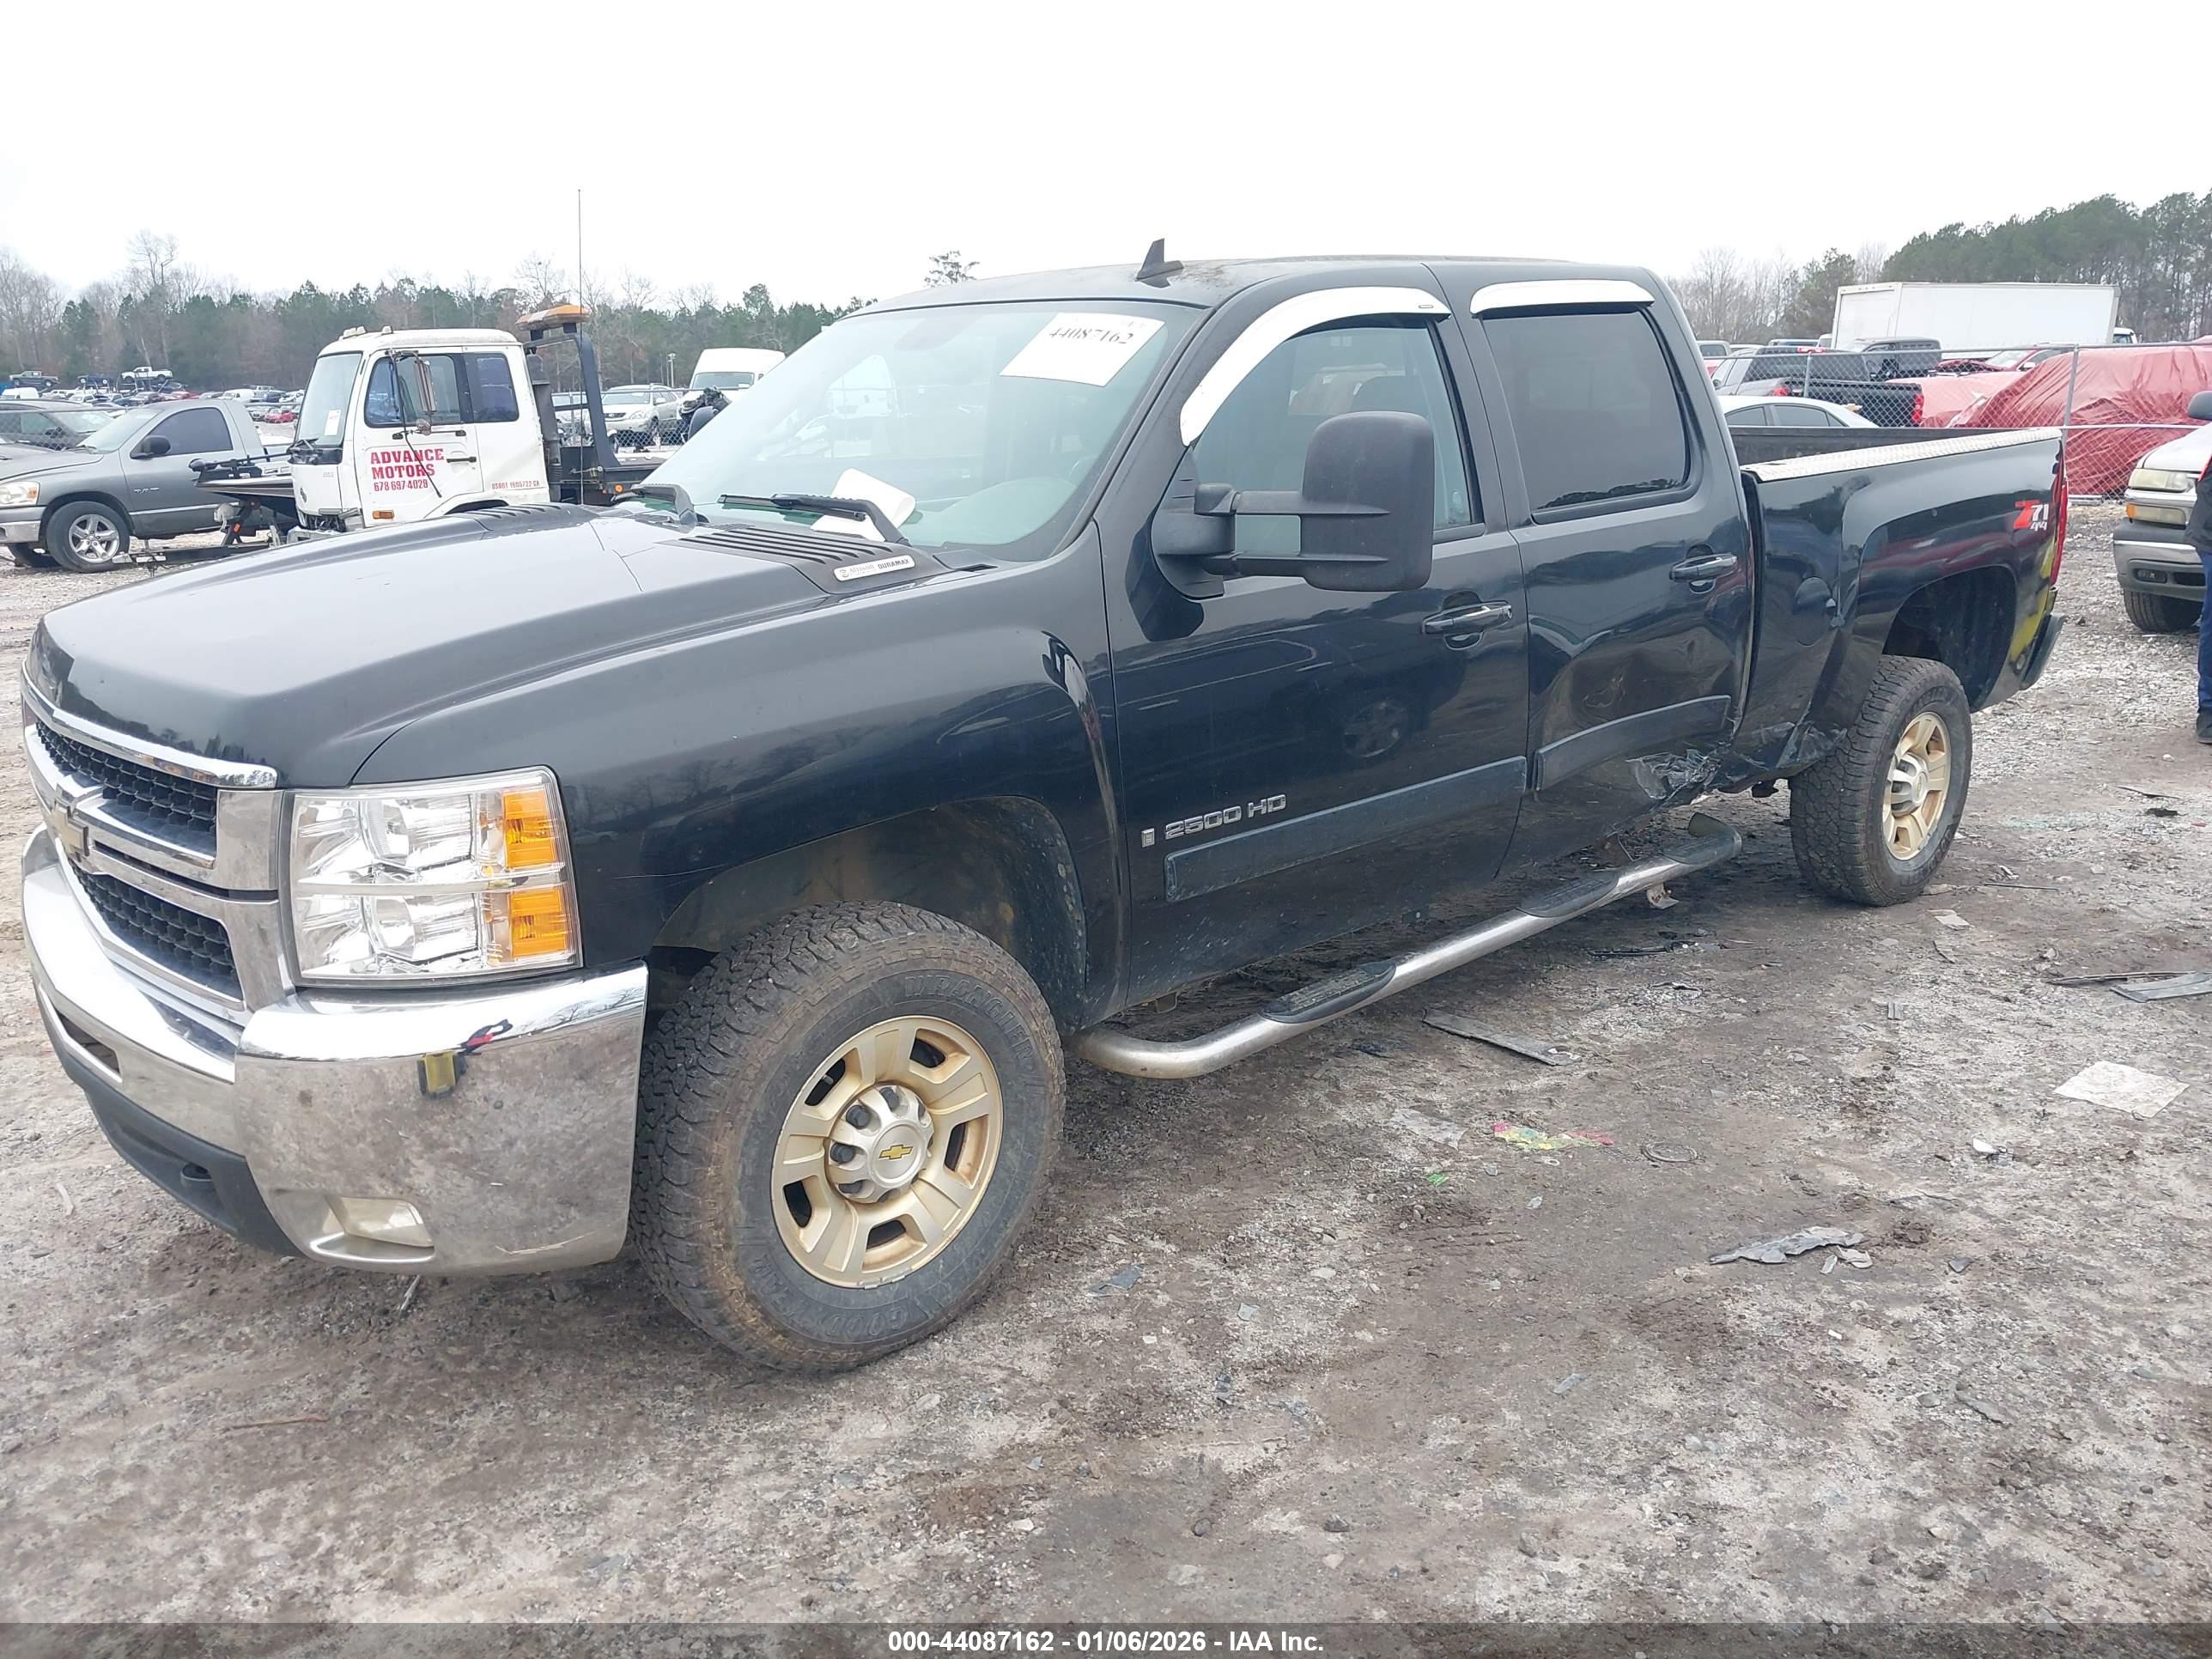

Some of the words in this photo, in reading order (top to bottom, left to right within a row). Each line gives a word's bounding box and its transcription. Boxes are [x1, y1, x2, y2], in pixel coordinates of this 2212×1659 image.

[1049, 327, 1134, 344] 44087162
[370, 448, 445, 465] ADVANCE
[371, 464, 435, 479] MOTORS
[374, 482, 390, 492] 678
[391, 480, 406, 490] 697
[407, 479, 428, 489] 4029
[878, 559, 909, 569] DURAMAX
[1165, 805, 1243, 840] 2500
[1247, 793, 1287, 818] HD
[905, 975, 1033, 1060] WRANGLER
